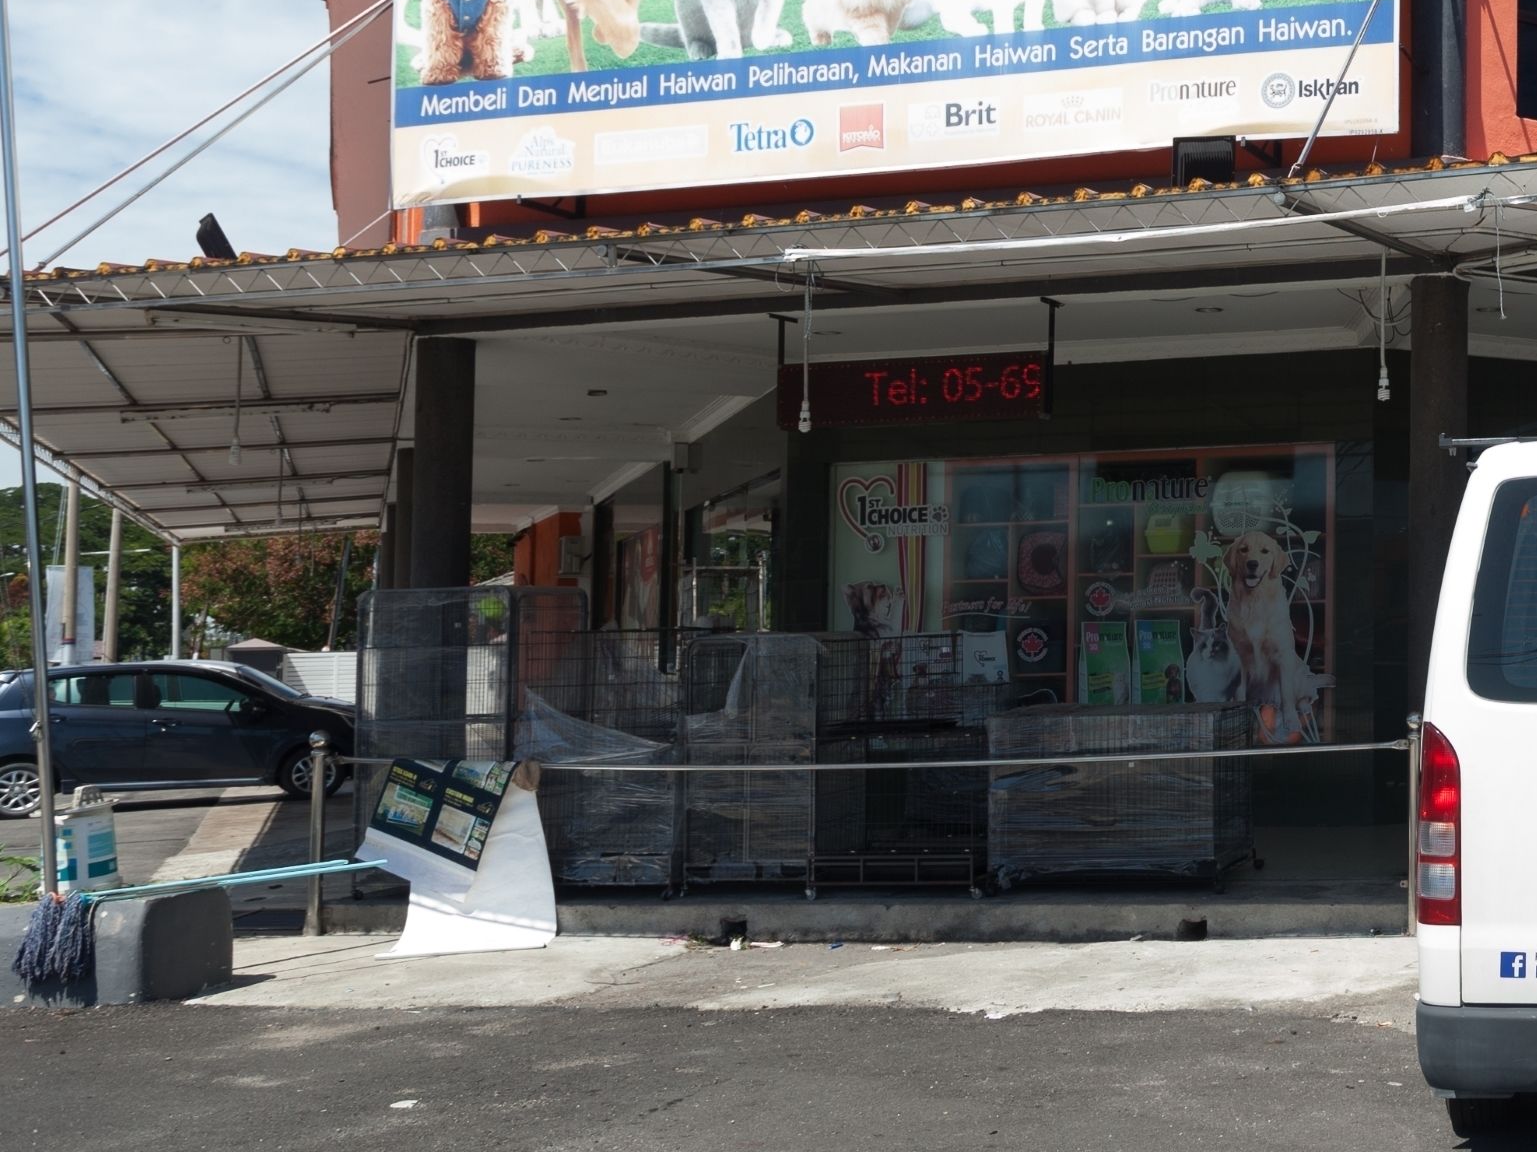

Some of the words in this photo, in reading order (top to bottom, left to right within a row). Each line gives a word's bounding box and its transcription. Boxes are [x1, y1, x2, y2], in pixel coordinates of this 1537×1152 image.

[420, 88, 507, 117] Membeli
[518, 85, 557, 109] Dan
[568, 76, 648, 105] Menjual
[660, 67, 736, 96] Haiwan
[748, 59, 859, 88] Peliharaan,
[867, 50, 962, 78] Makanan
[975, 41, 1056, 68] Haiwan
[1069, 33, 1128, 60] Serta
[1141, 23, 1245, 52] Barangan
[1258, 15, 1352, 43] Haiwan.
[1299, 78, 1360, 100] Iskhan
[944, 101, 997, 128] Brit
[1025, 111, 1070, 129] ROYAL
[1074, 107, 1122, 124] CANIN
[730, 122, 787, 153] Tetra
[439, 154, 476, 168] CHOICE
[511, 158, 572, 172] PURENESS
[864, 368, 928, 406] Tel:
[1091, 475, 1209, 503] Pronature
[868, 506, 928, 526] CHOICE
[887, 523, 948, 535] NUTRITION
